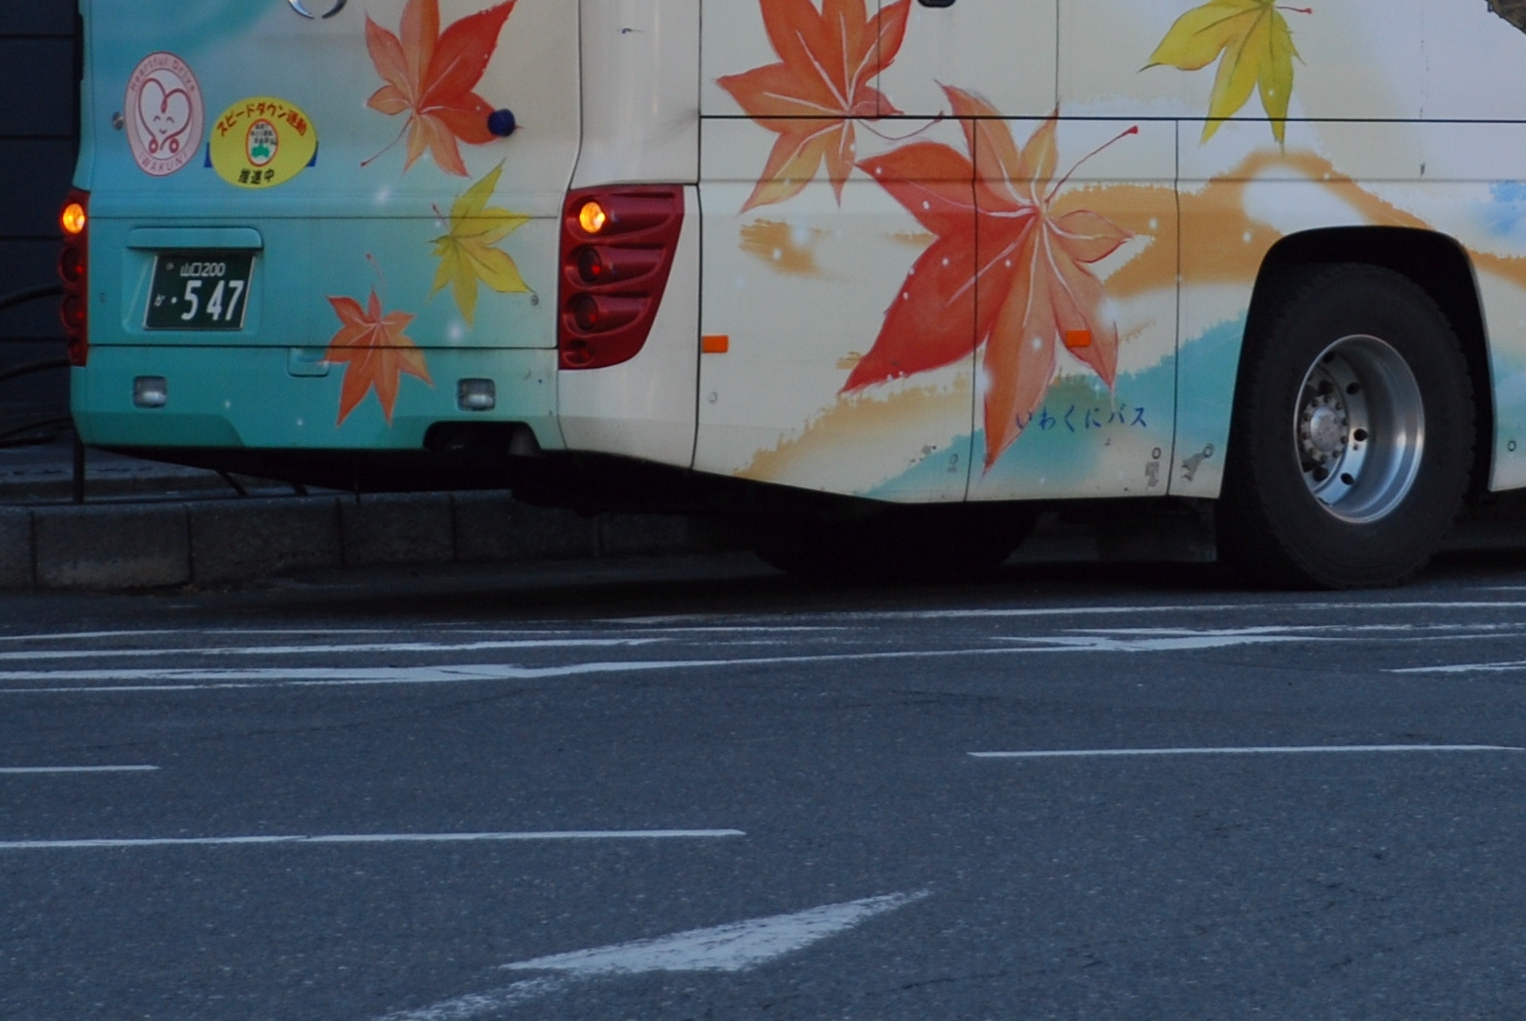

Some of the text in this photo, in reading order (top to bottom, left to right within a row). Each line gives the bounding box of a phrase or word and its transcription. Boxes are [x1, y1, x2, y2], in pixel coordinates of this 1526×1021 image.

[216, 101, 307, 136] スピードダウン運動
[238, 169, 275, 185] 推進中
[1015, 403, 1147, 433] いわくにバス
